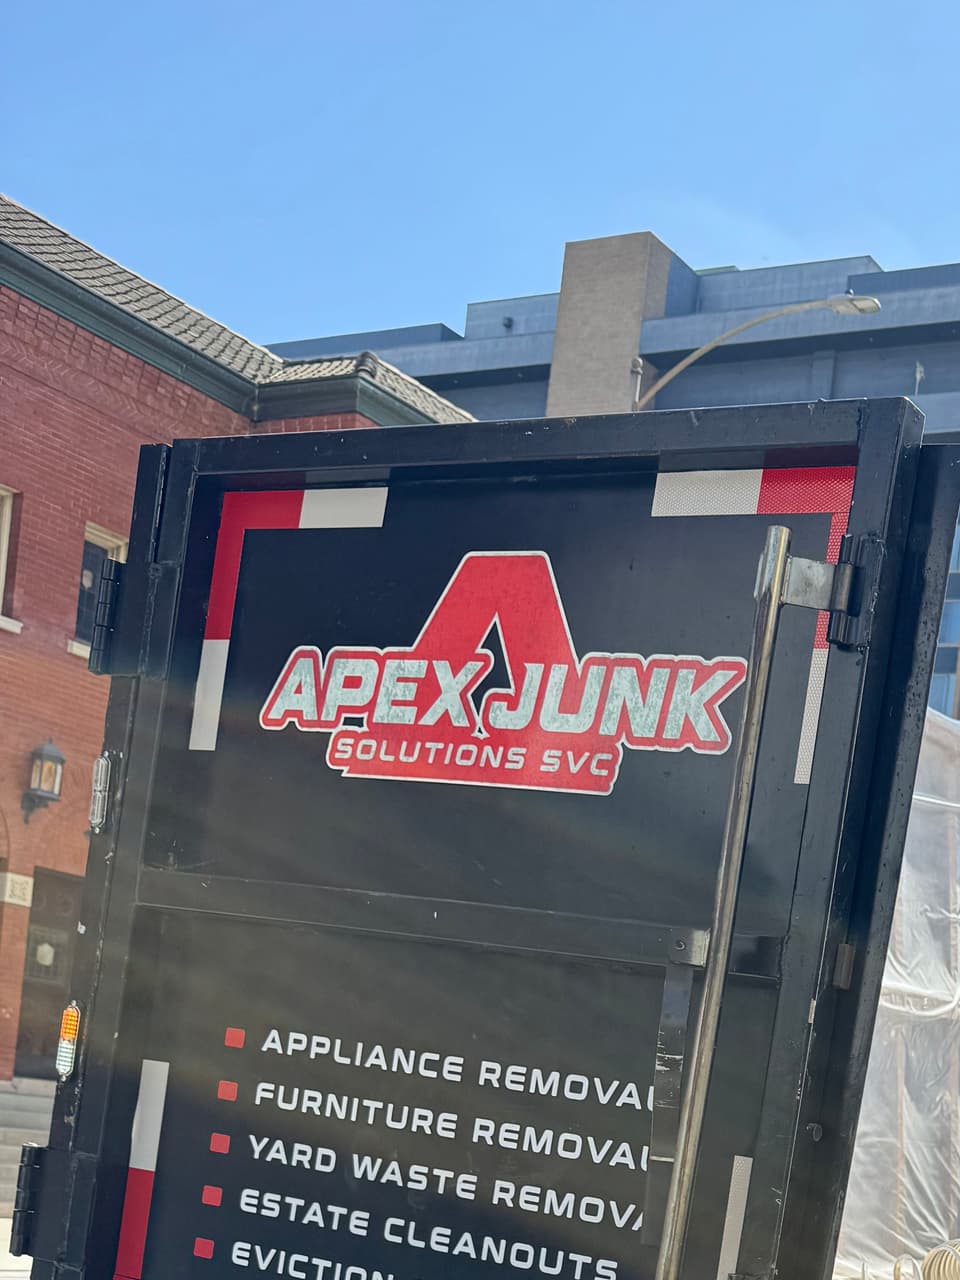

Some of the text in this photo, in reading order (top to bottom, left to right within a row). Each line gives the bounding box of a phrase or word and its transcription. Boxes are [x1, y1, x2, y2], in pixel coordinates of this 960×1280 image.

[267, 657, 739, 743] APEX JUNK
[334, 737, 613, 776] SOLUTIONS SVC
[261, 1028, 465, 1082] APPLIANCE
[254, 1081, 458, 1139] FURNITURE
[248, 1133, 644, 1232] YARD WASTE REMOV
[239, 1187, 370, 1236] ESTATE
